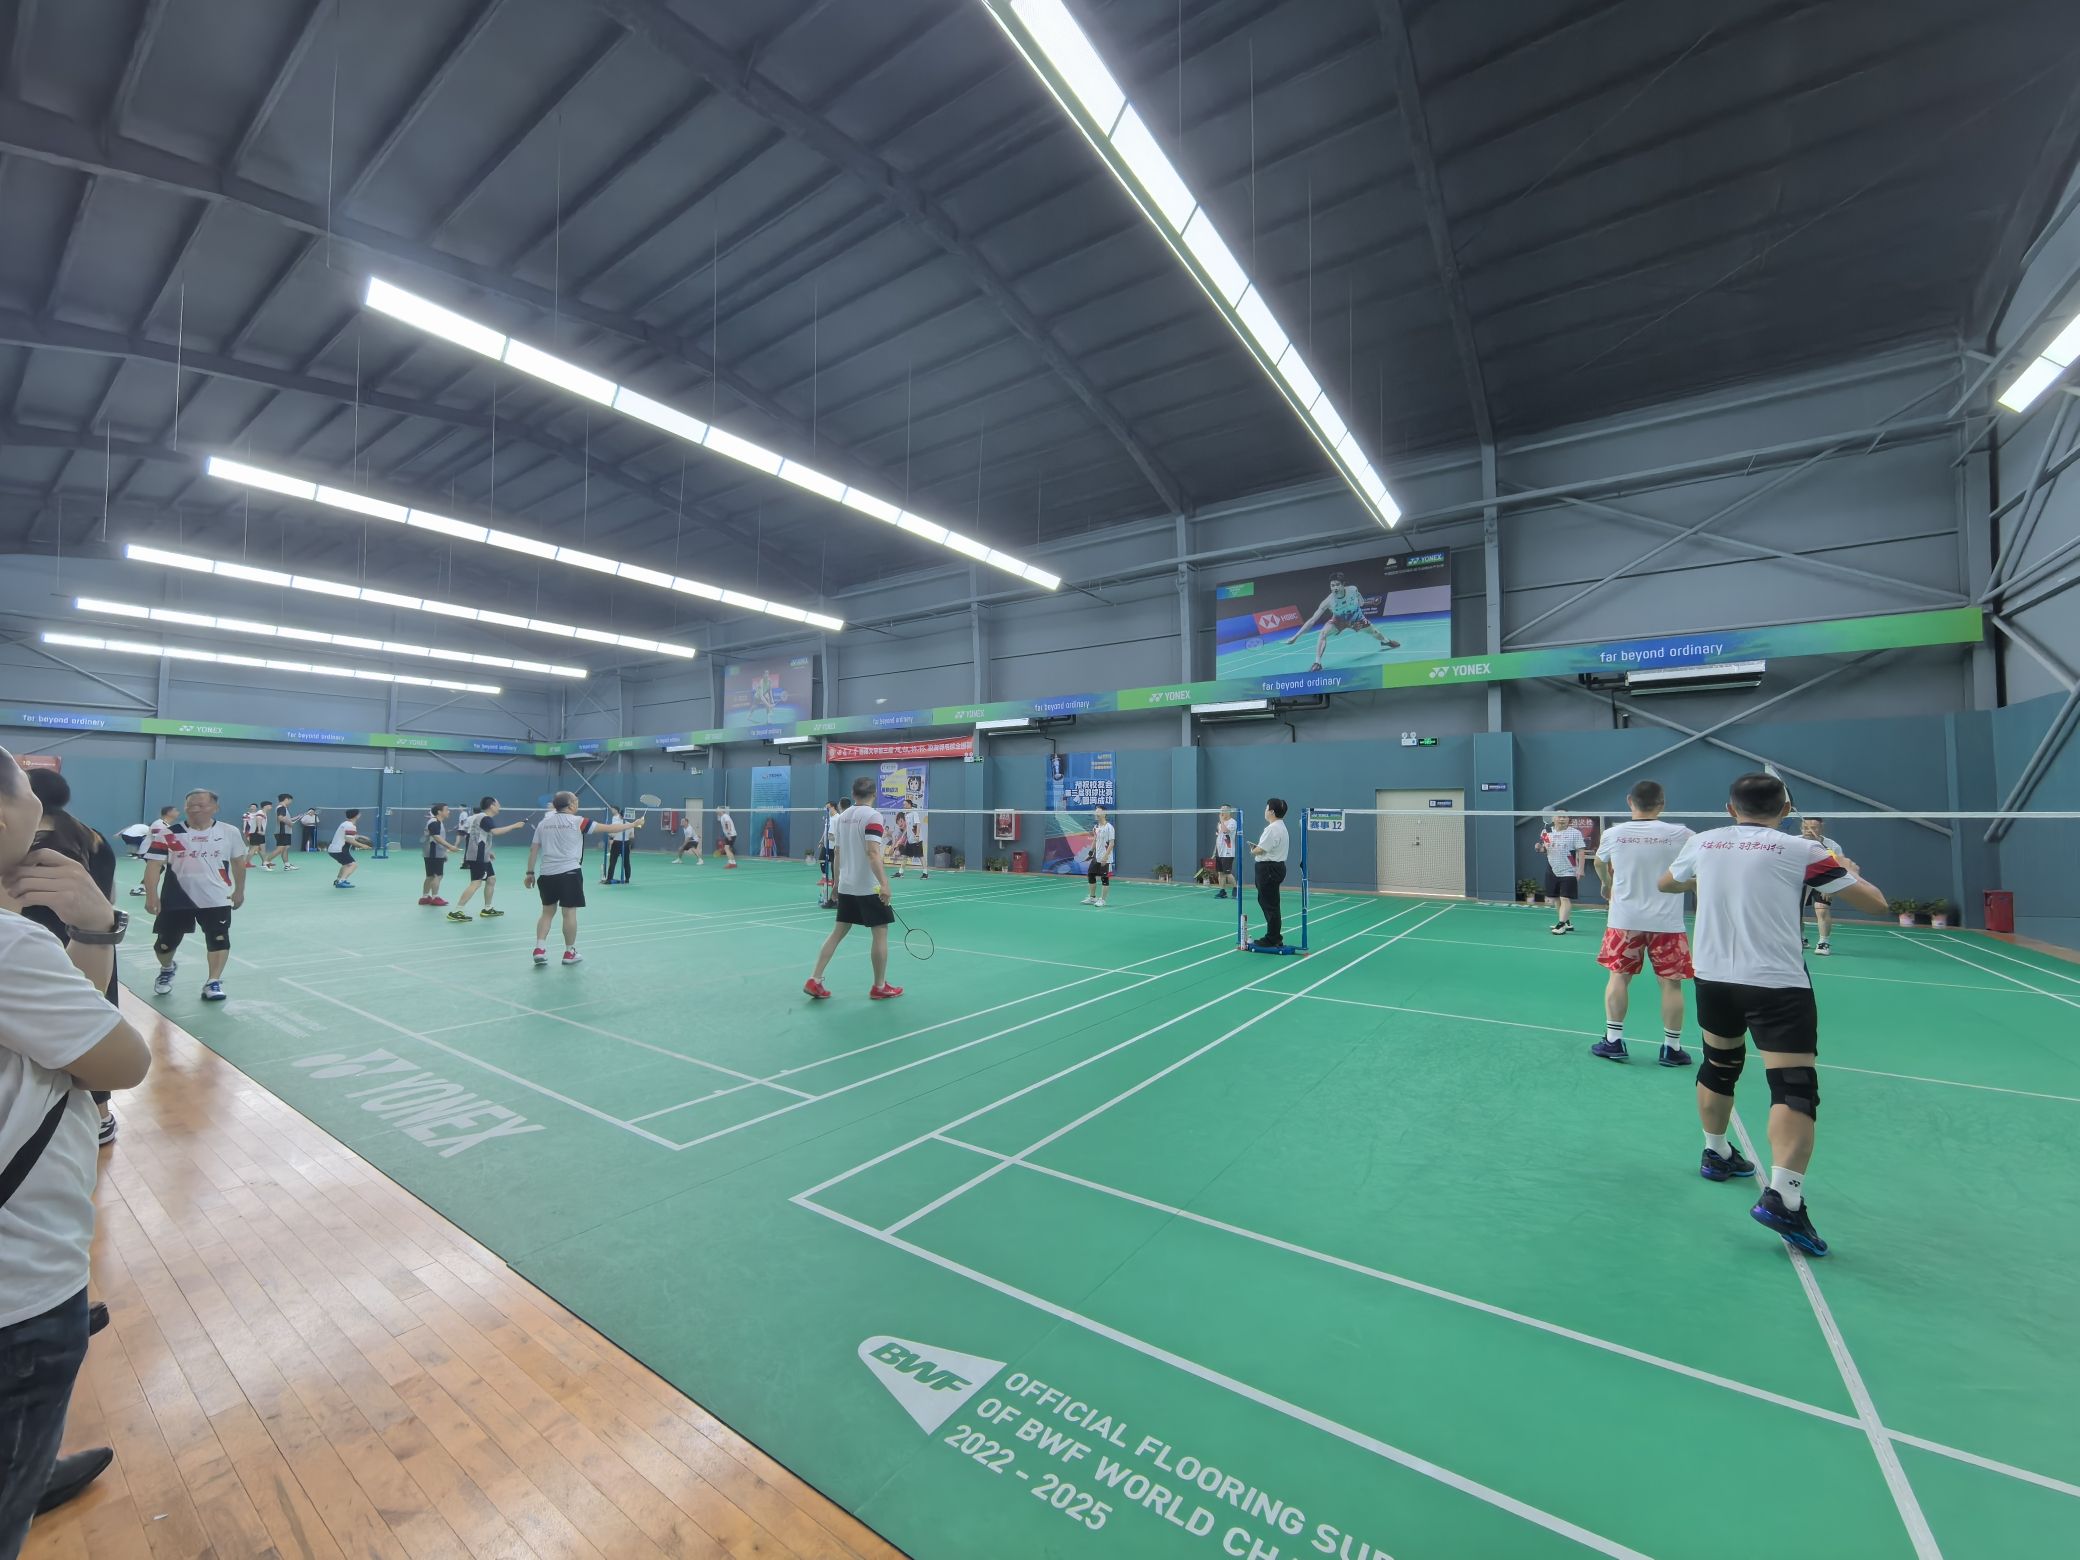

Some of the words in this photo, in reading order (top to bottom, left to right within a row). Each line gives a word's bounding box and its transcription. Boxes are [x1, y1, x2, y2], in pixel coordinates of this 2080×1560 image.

[1421, 554, 1442, 562] YONEX
[1280, 613, 1297, 621] HSBC
[1600, 652, 1617, 663] far
[1621, 647, 1664, 662] beyond
[1669, 644, 1723, 656] ordinary
[1452, 663, 1491, 677] YONEX
[1262, 682, 1273, 691] far
[1275, 678, 1303, 691] beyond
[1307, 676, 1341, 686] ordinary
[1164, 690, 1190, 701] YONEX
[1034, 704, 1042, 712] far
[1044, 702, 1064, 712] beyond
[1065, 700, 1089, 709] ordinary
[22, 714, 35, 722] far
[38, 715, 69, 724] beyond
[71, 719, 105, 727] ordinary
[1333, 821, 1342, 830] 12
[344, 1072, 547, 1158] YONEX
[868, 1342, 973, 1391] BWF
[1005, 1373, 1127, 1447] OFFICIAL
[1134, 1435, 1306, 1535] FLOORING
[977, 1398, 1022, 1425] OF
[1015, 1418, 1092, 1463] BWF
[1094, 1456, 1215, 1537] WORLD
[944, 1425, 1015, 1474] 2022
[1015, 1470, 1030, 1480] -
[1031, 1474, 1113, 1530] 2025
